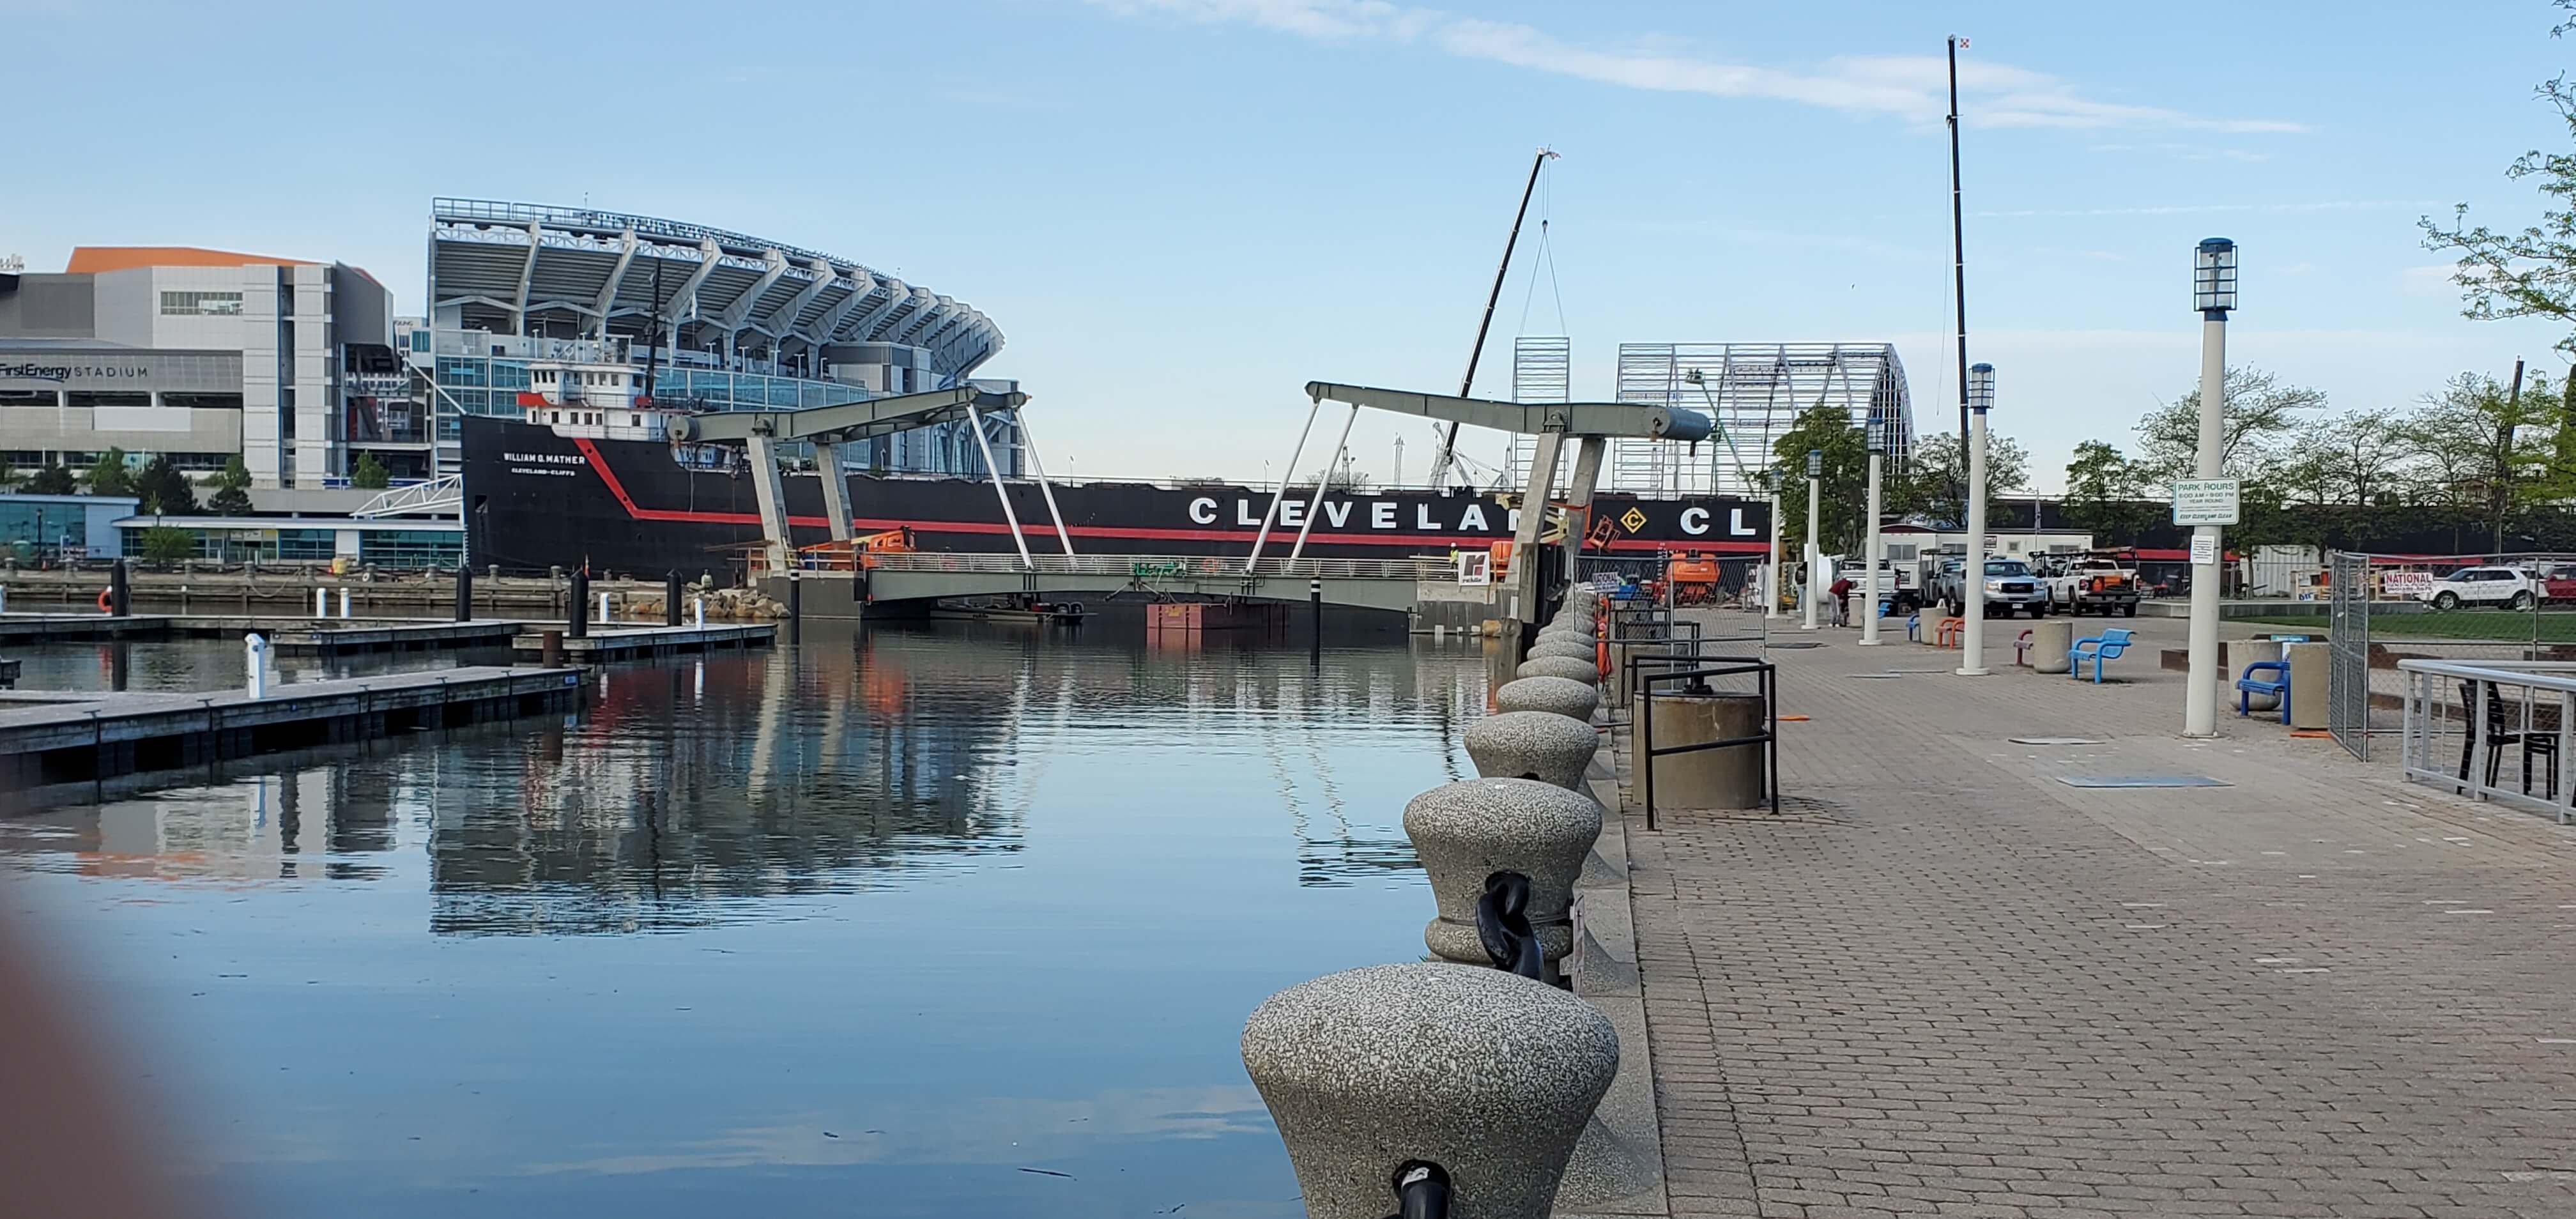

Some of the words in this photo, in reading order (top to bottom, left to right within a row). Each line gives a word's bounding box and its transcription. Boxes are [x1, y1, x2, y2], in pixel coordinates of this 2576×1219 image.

[0, 364, 72, 379] FirstEnergy
[74, 367, 148, 378] STADIUM
[503, 453, 536, 462] WILLIAM
[546, 456, 585, 464] MATHER
[1189, 496, 1567, 533] CLEVELA
[2386, 574, 2432, 583] NATIONAL
